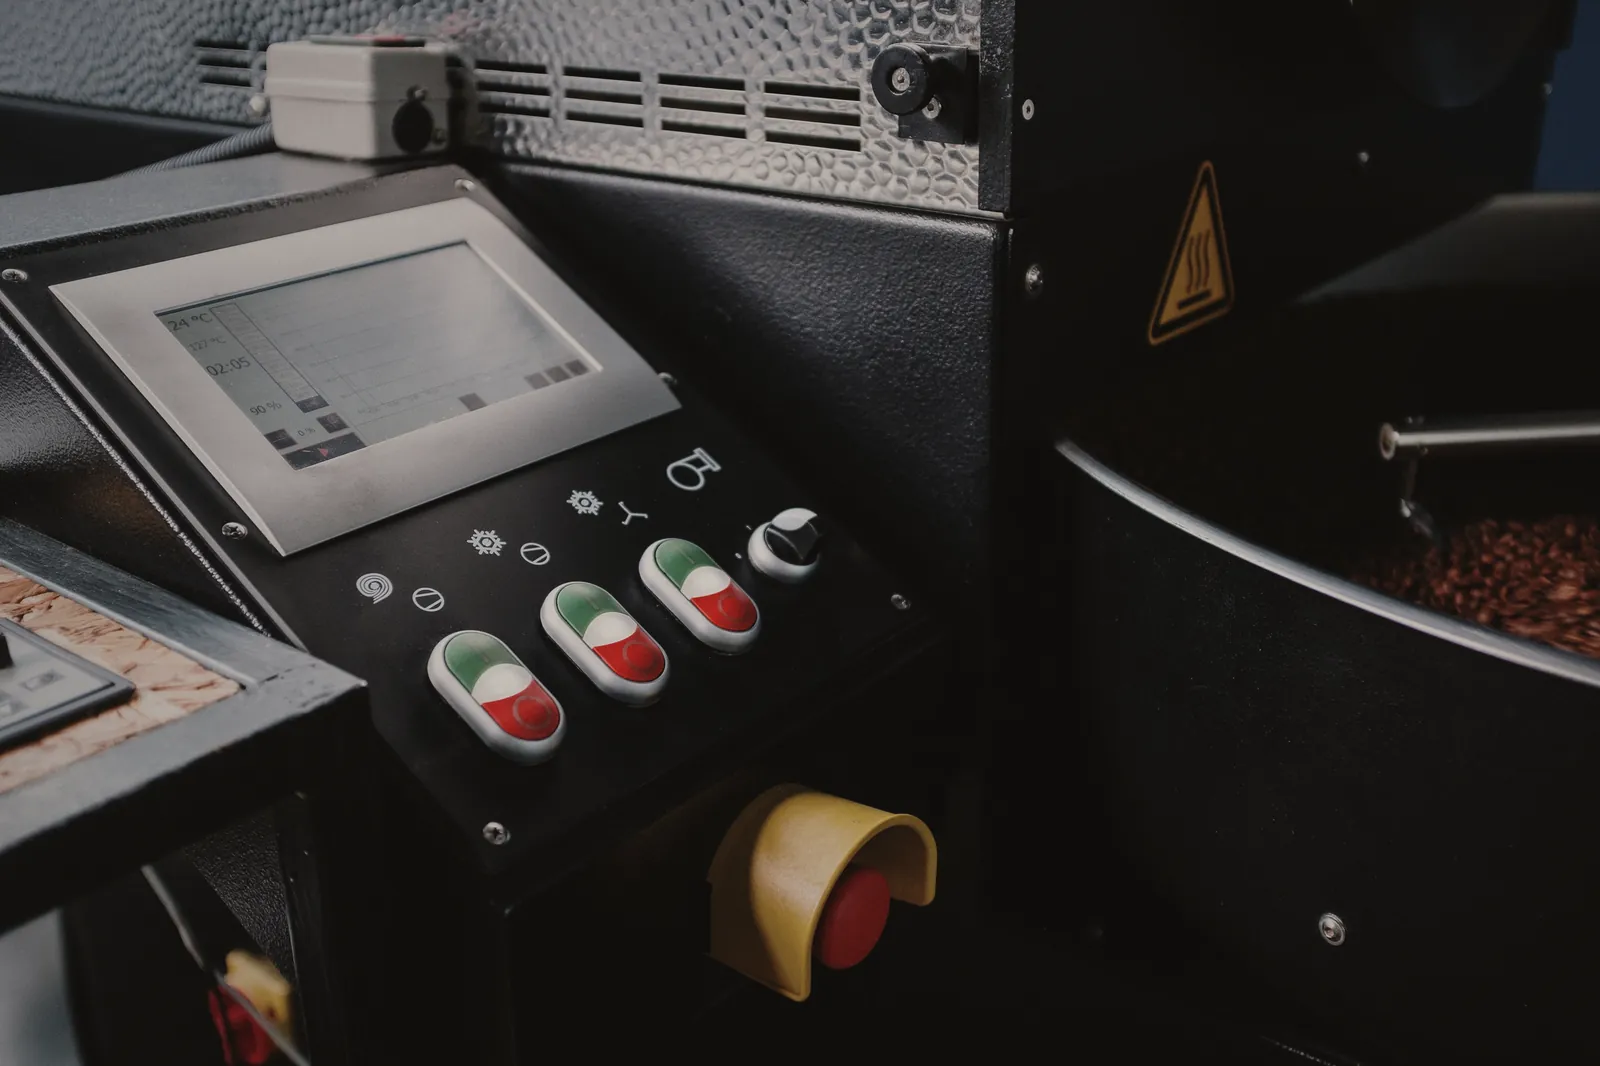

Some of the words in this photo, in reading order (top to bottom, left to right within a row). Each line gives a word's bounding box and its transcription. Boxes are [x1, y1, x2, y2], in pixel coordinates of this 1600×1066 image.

[168, 317, 190, 331] 24
[205, 356, 251, 377] 02:05
[249, 404, 267, 416] 90
